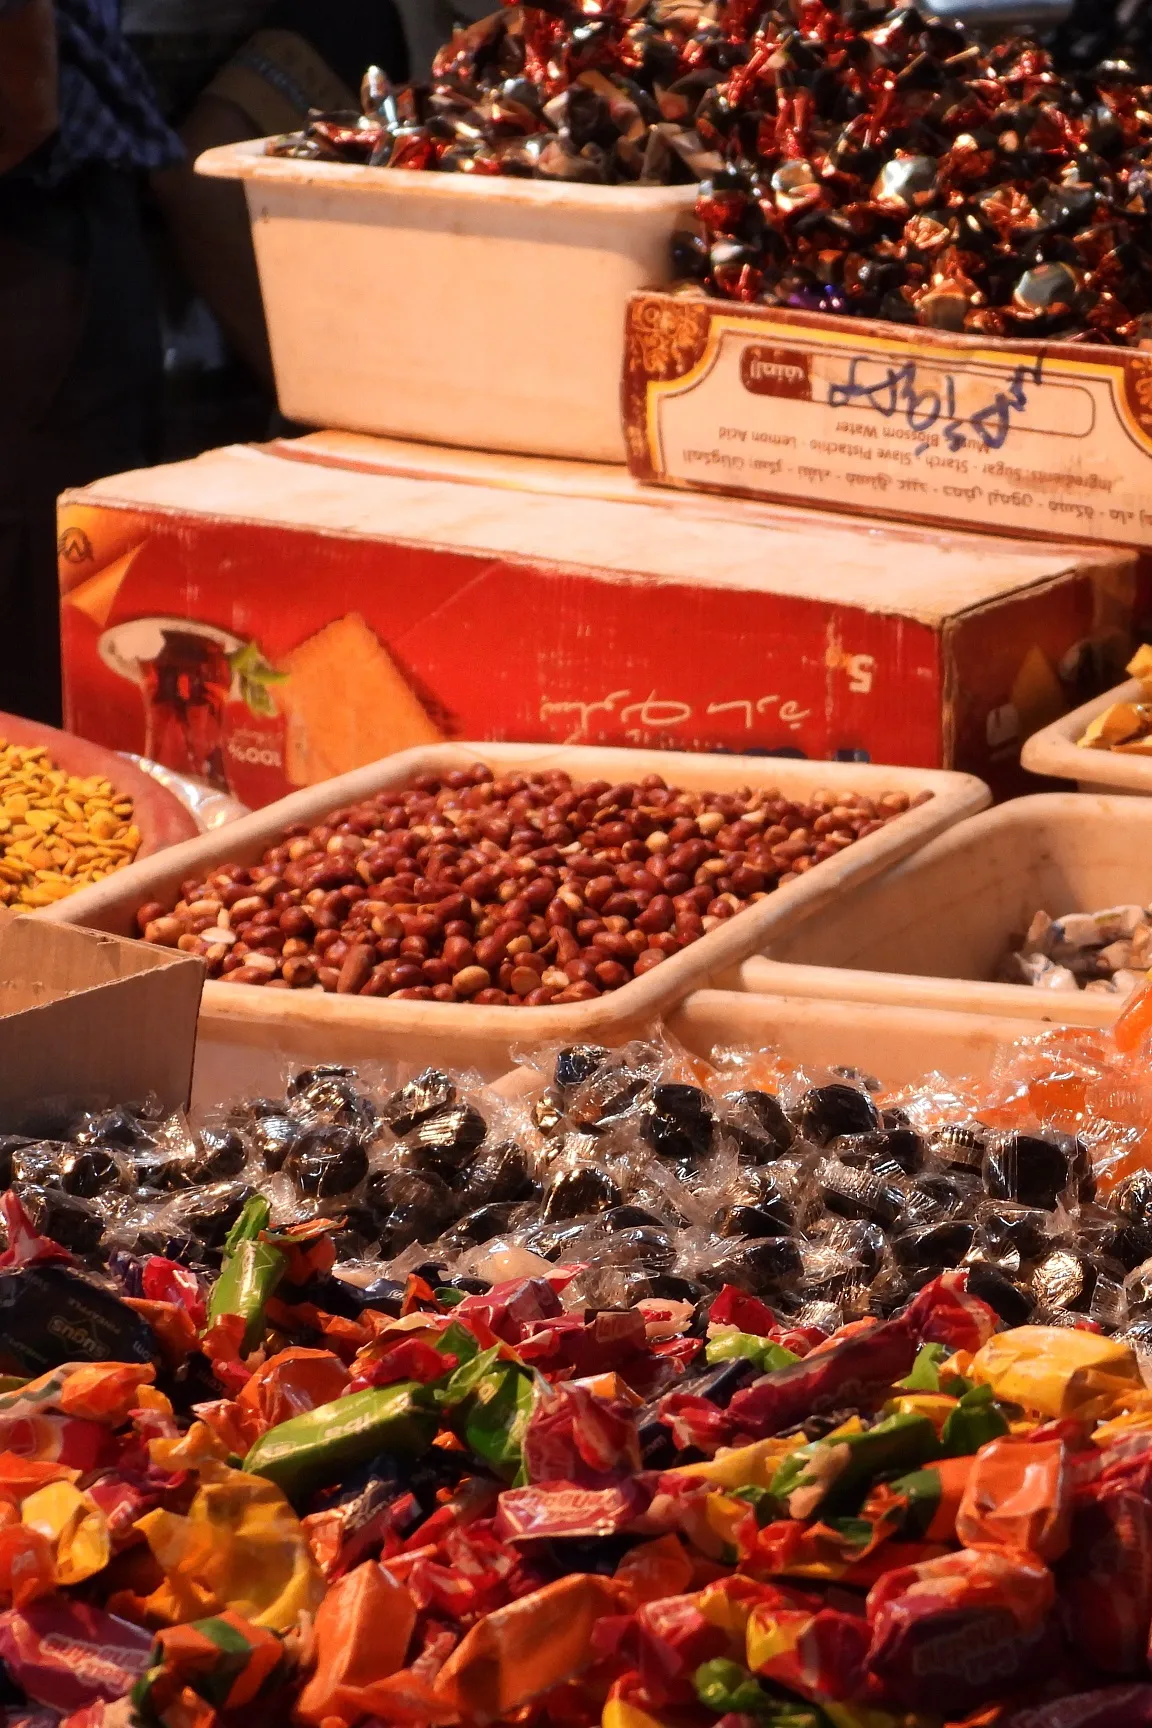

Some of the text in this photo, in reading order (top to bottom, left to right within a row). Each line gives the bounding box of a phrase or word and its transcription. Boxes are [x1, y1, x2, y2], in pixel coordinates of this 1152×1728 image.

[750, 360, 804, 385] الصنف
[719, 426, 747, 442] Acid
[752, 431, 797, 449] Lemon
[835, 421, 878, 440] Water
[882, 426, 940, 448] Blossom
[810, 439, 872, 461] Pistachio
[877, 448, 912, 466] Slave
[926, 455, 968, 474] Starch
[983, 461, 1022, 483] Sugar
[988, 489, 1033, 507] ليمون
[227, 744, 282, 768] 100%
